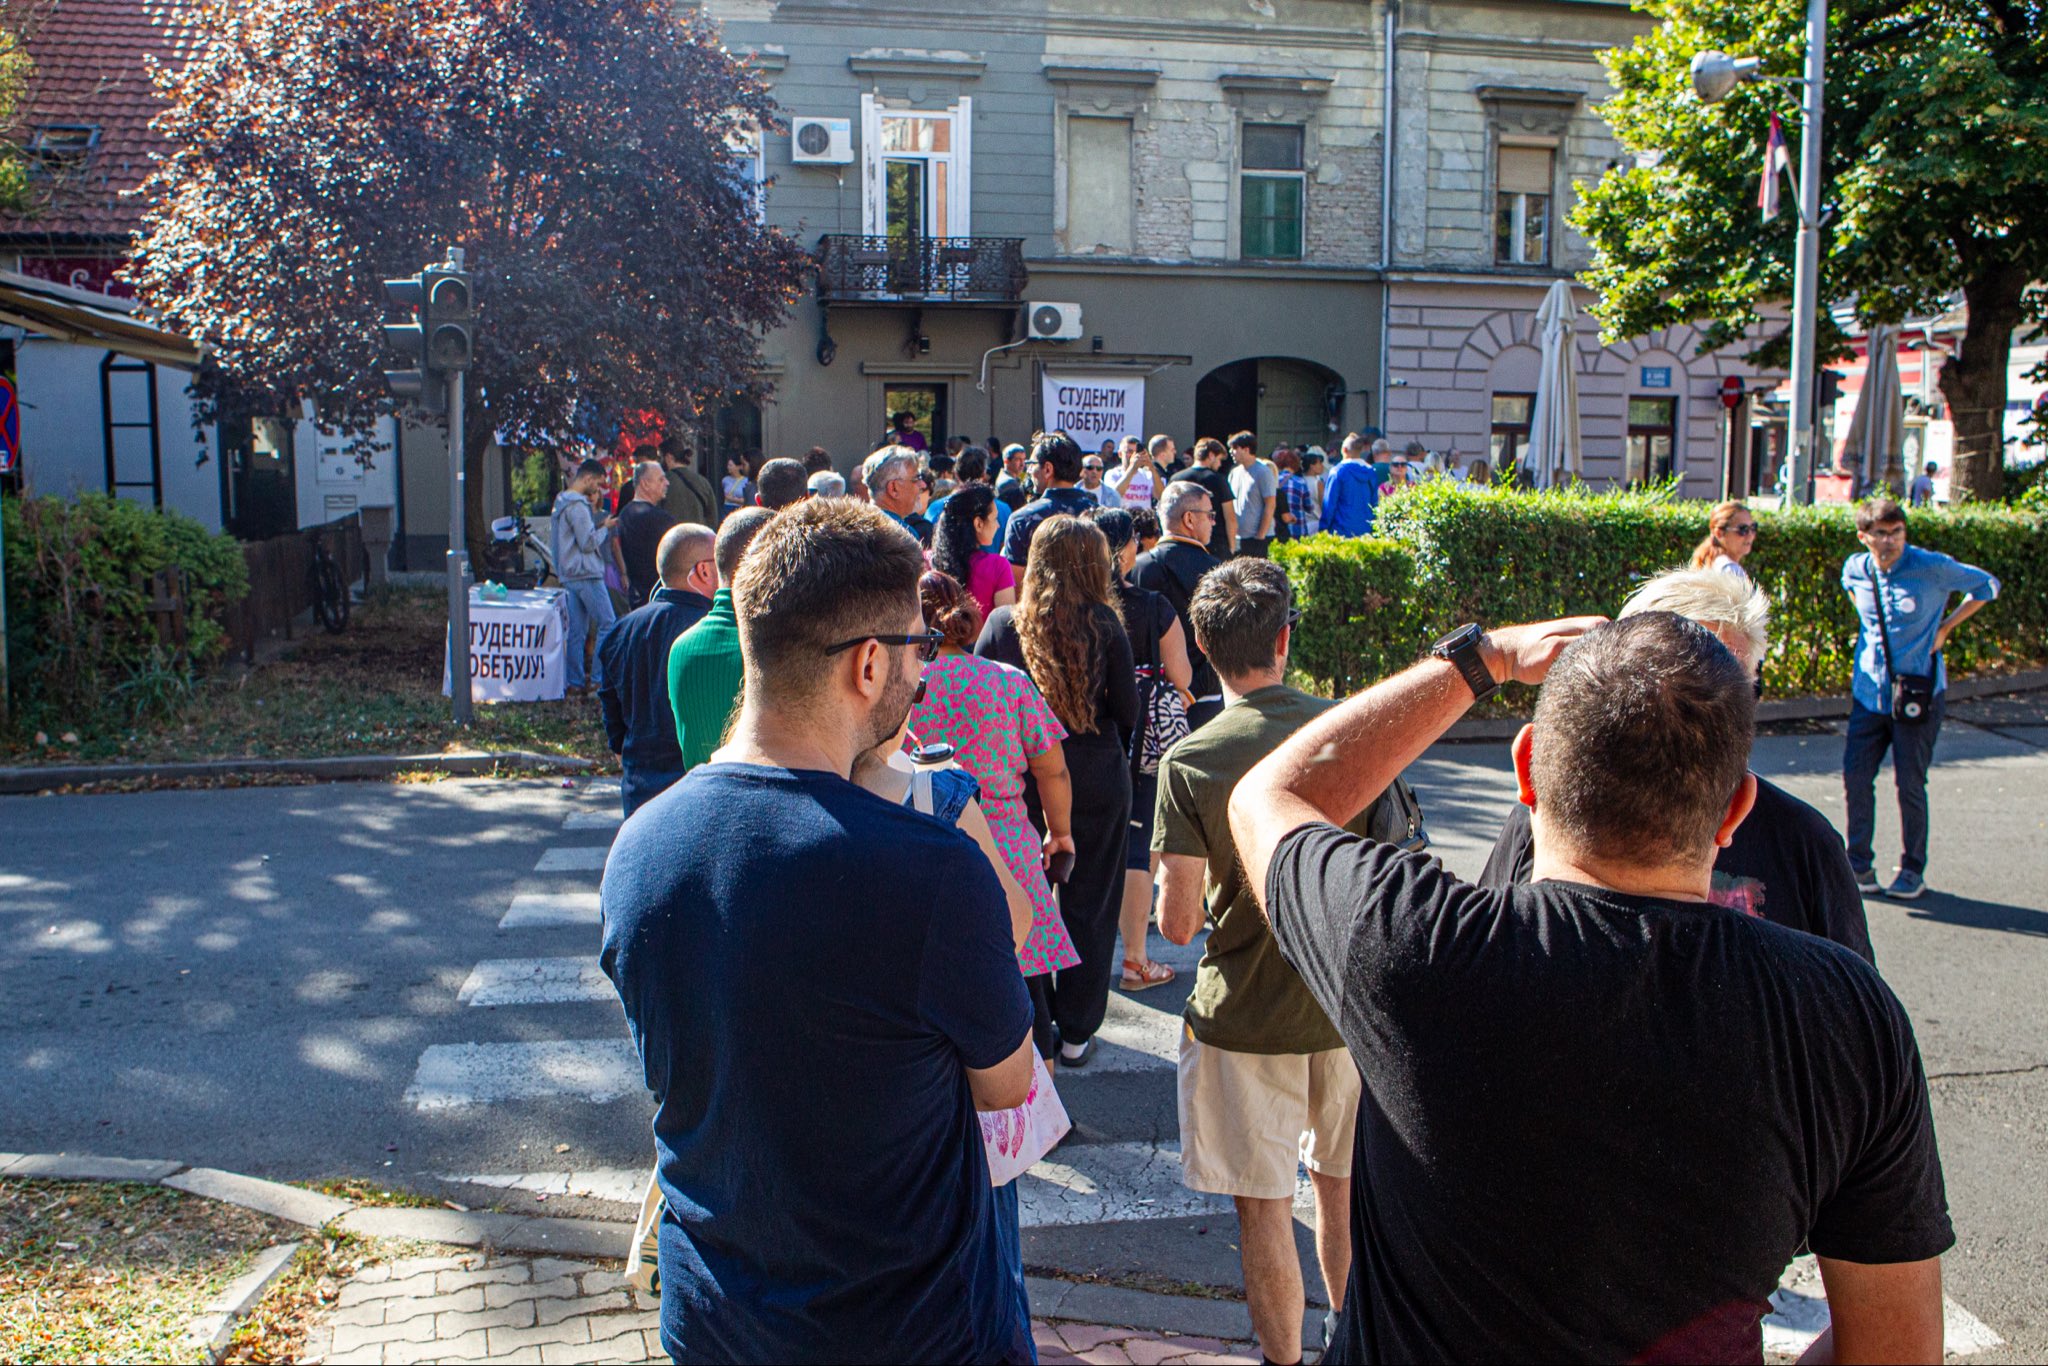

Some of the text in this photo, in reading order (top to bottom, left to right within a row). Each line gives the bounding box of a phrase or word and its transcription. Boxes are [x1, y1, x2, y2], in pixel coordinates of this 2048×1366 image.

[1058, 386, 1125, 410] СТУДЕНТИ
[1057, 410, 1125, 434] ПОБЕЂУЈУ!
[469, 622, 546, 652] ТУДЕНТИ
[469, 653, 545, 684] ОБЕЂУЈУ!
